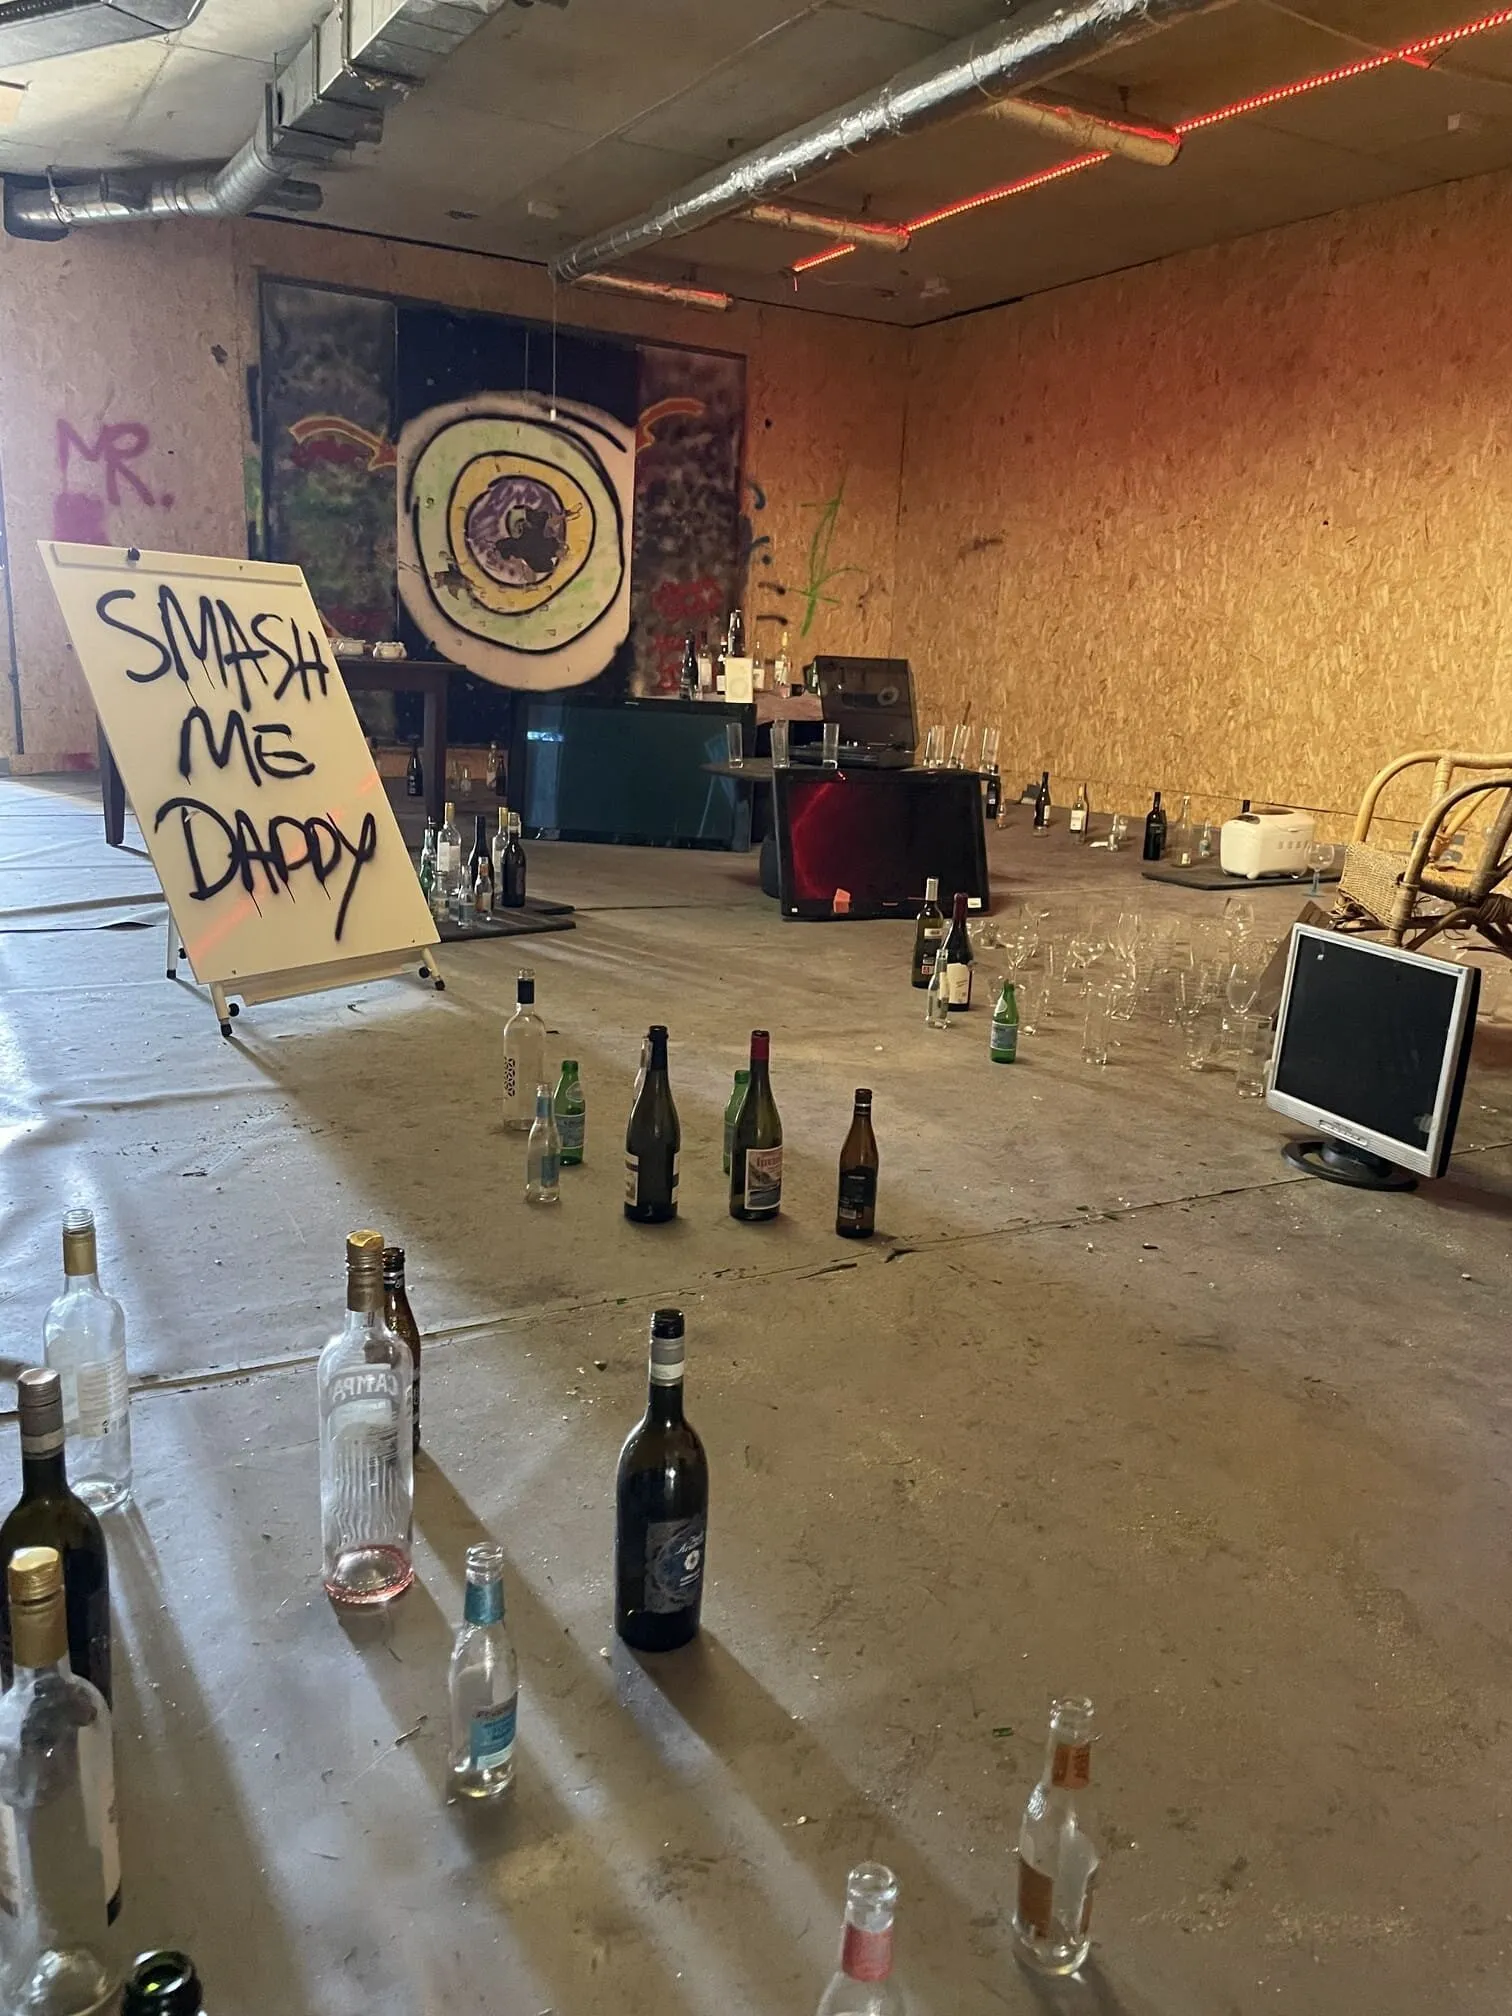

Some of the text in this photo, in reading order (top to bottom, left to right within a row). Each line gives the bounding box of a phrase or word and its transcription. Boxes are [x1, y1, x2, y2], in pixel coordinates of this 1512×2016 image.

[96, 585, 329, 711] SMASH
[178, 706, 315, 786] ME
[154, 797, 376, 941] DADDY
